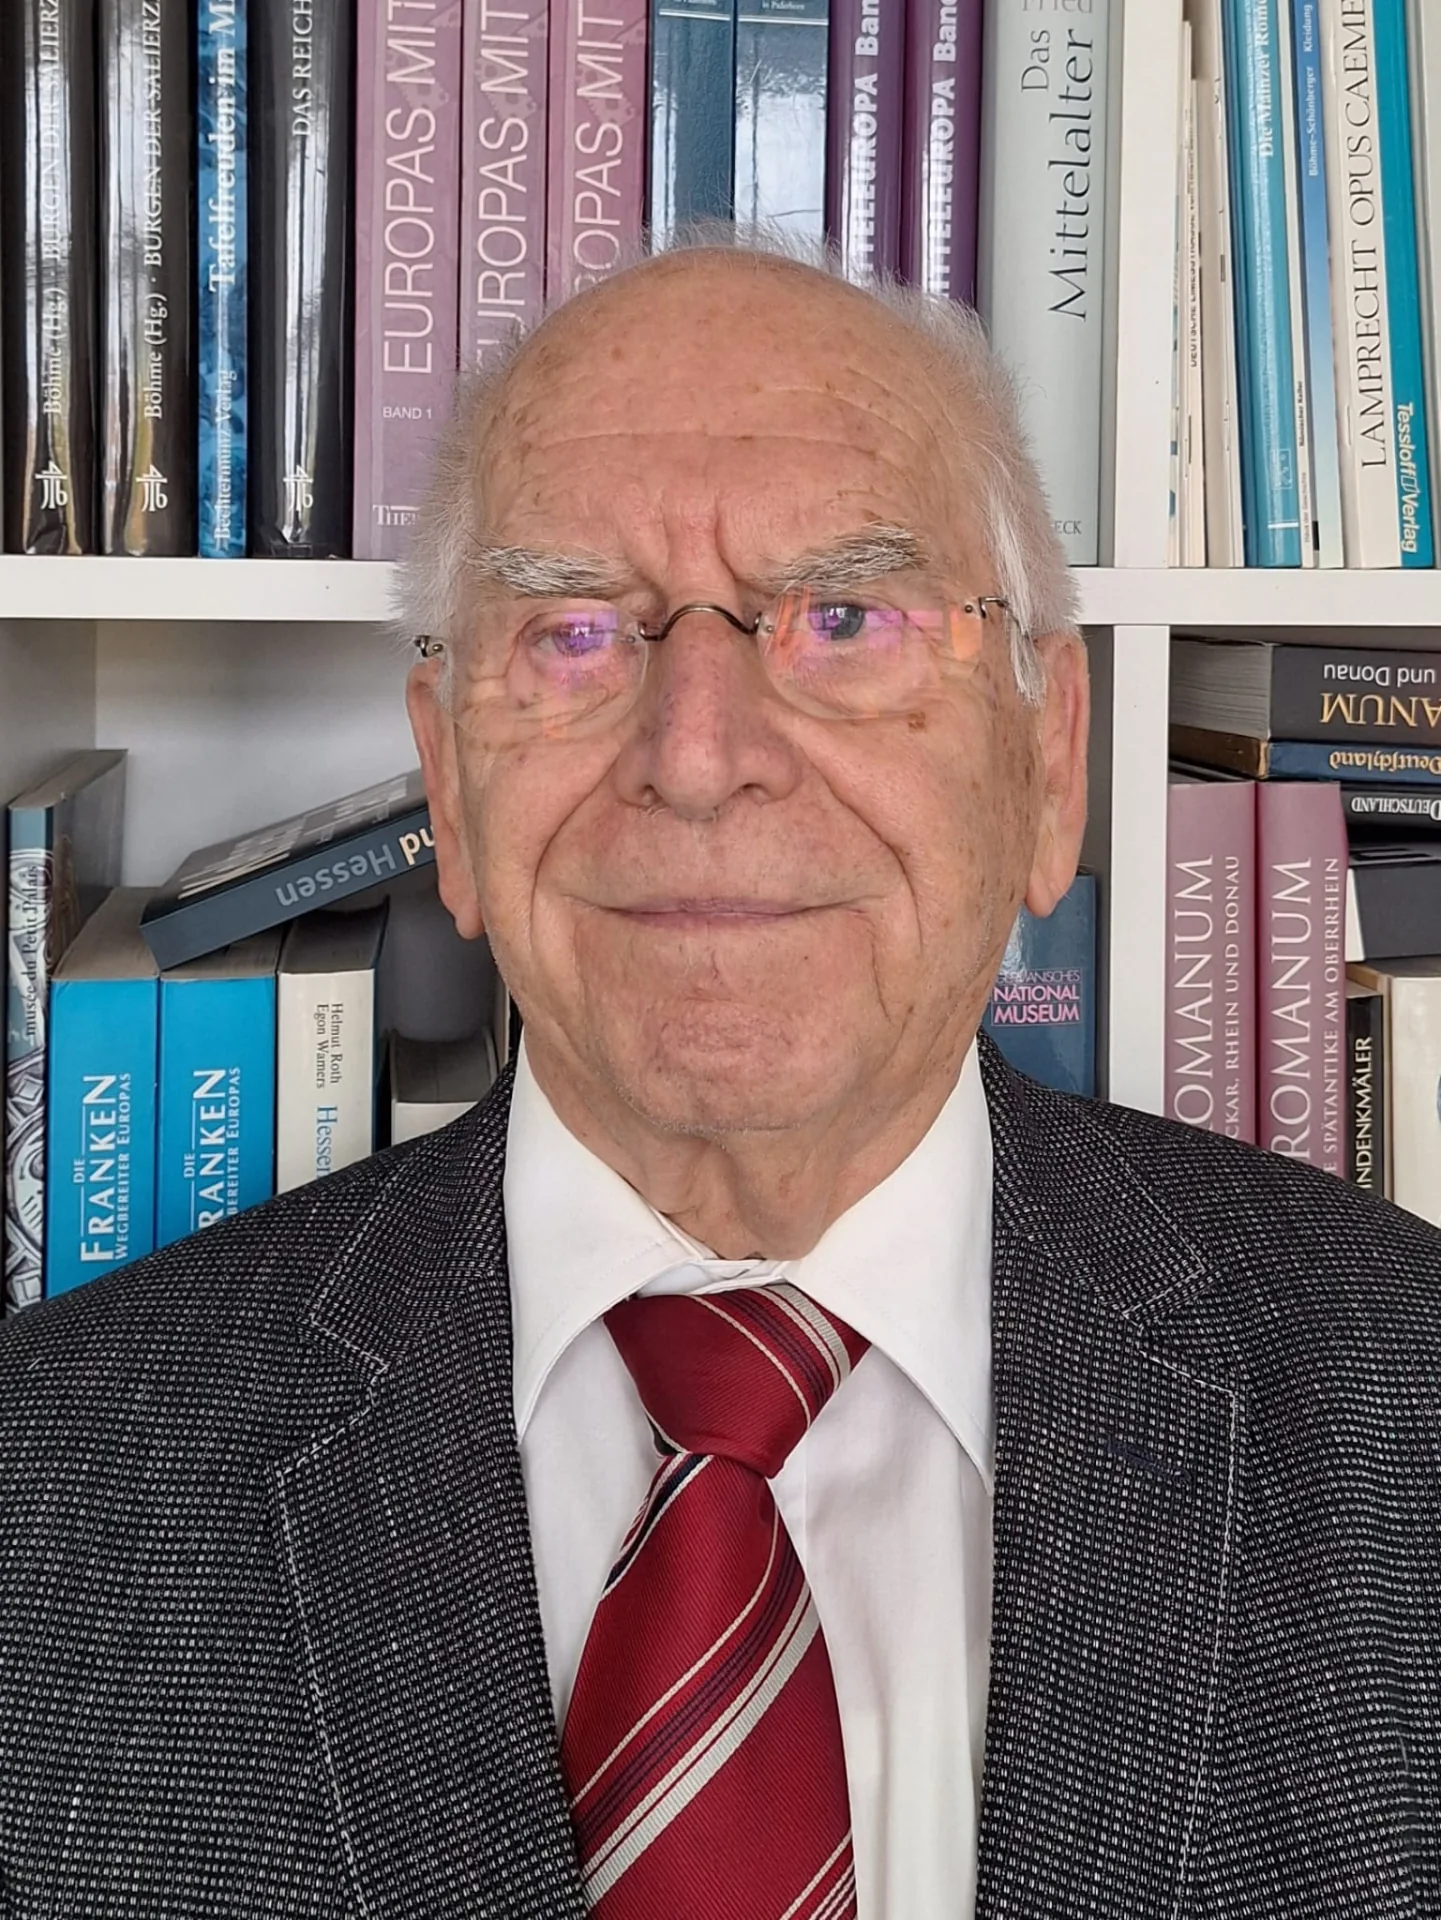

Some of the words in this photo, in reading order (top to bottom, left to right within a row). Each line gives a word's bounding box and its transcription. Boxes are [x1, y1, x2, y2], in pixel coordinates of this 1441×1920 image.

[292, 0, 313, 79] REICH
[386, 0, 437, 85] MIT
[480, 0, 530, 95] MIT
[576, 0, 625, 99] MIT
[1303, 3, 1313, 53] Kleidung
[208, 47, 236, 86] im
[1020, 29, 1051, 93] Das
[1255, 51, 1273, 123] Mainzer
[42, 102, 61, 150] DER
[143, 109, 162, 157] DER
[292, 87, 313, 138] DAS
[1258, 126, 1274, 158] Die
[1303, 65, 1319, 177] Böhme-Schönberger
[208, 96, 236, 293] Tafelfreuden
[1047, 28, 1094, 323] Mittelalter
[1346, 134, 1375, 227] OPUS
[42, 158, 61, 261] BURGEN
[143, 165, 162, 267] BURGEN
[383, 108, 437, 374] EUROPAS
[476, 116, 530, 366] UROPAS
[42, 287, 67, 339] (Hg.)
[143, 293, 168, 345] (Hg.)
[43, 347, 62, 415] Böhme
[143, 351, 163, 419] Böhme
[1352, 238, 1387, 469] LAMPRECHT
[213, 369, 238, 423] Verlag
[382, 406, 423, 420] BAND
[425, 407, 433, 420] 1
[1396, 401, 1418, 477] Tessloff
[1400, 492, 1421, 553] Verlag
[1322, 663, 1391, 687] Donau
[1396, 666, 1436, 688] und
[1319, 692, 1441, 729] ANUM
[20, 865, 38, 914] Palais
[275, 843, 397, 907] Hessen
[1224, 855, 1241, 935] DONAU
[21, 918, 38, 955] Petit
[1324, 857, 1340, 983] OBERRHEIN
[21, 962, 38, 981] du
[993, 984, 1080, 1002] NATIONAL
[1173, 854, 1214, 1128] OMANUM
[1224, 943, 1240, 993] UND
[21, 985, 37, 1036] musée
[314, 1003, 330, 1036] Egon
[330, 1002, 344, 1048] Helmut
[993, 1002, 1080, 1024] MUSEUM
[1224, 1002, 1240, 1071] RHEIN
[1271, 857, 1313, 1160] ROMANUM
[1324, 990, 1340, 1023] AM
[330, 1052, 343, 1085] Roth
[1323, 1029, 1340, 1154] SPÄTANTIKE
[116, 1072, 132, 1145] EUROPAS
[226, 1067, 241, 1139] EUROPAS
[73, 1158, 86, 1184] DIE
[80, 1074, 117, 1262] FRANKEN
[184, 1152, 196, 1179] DIE
[193, 1068, 227, 1229] RANKEN
[115, 1152, 131, 1261] WEGBEREITER
